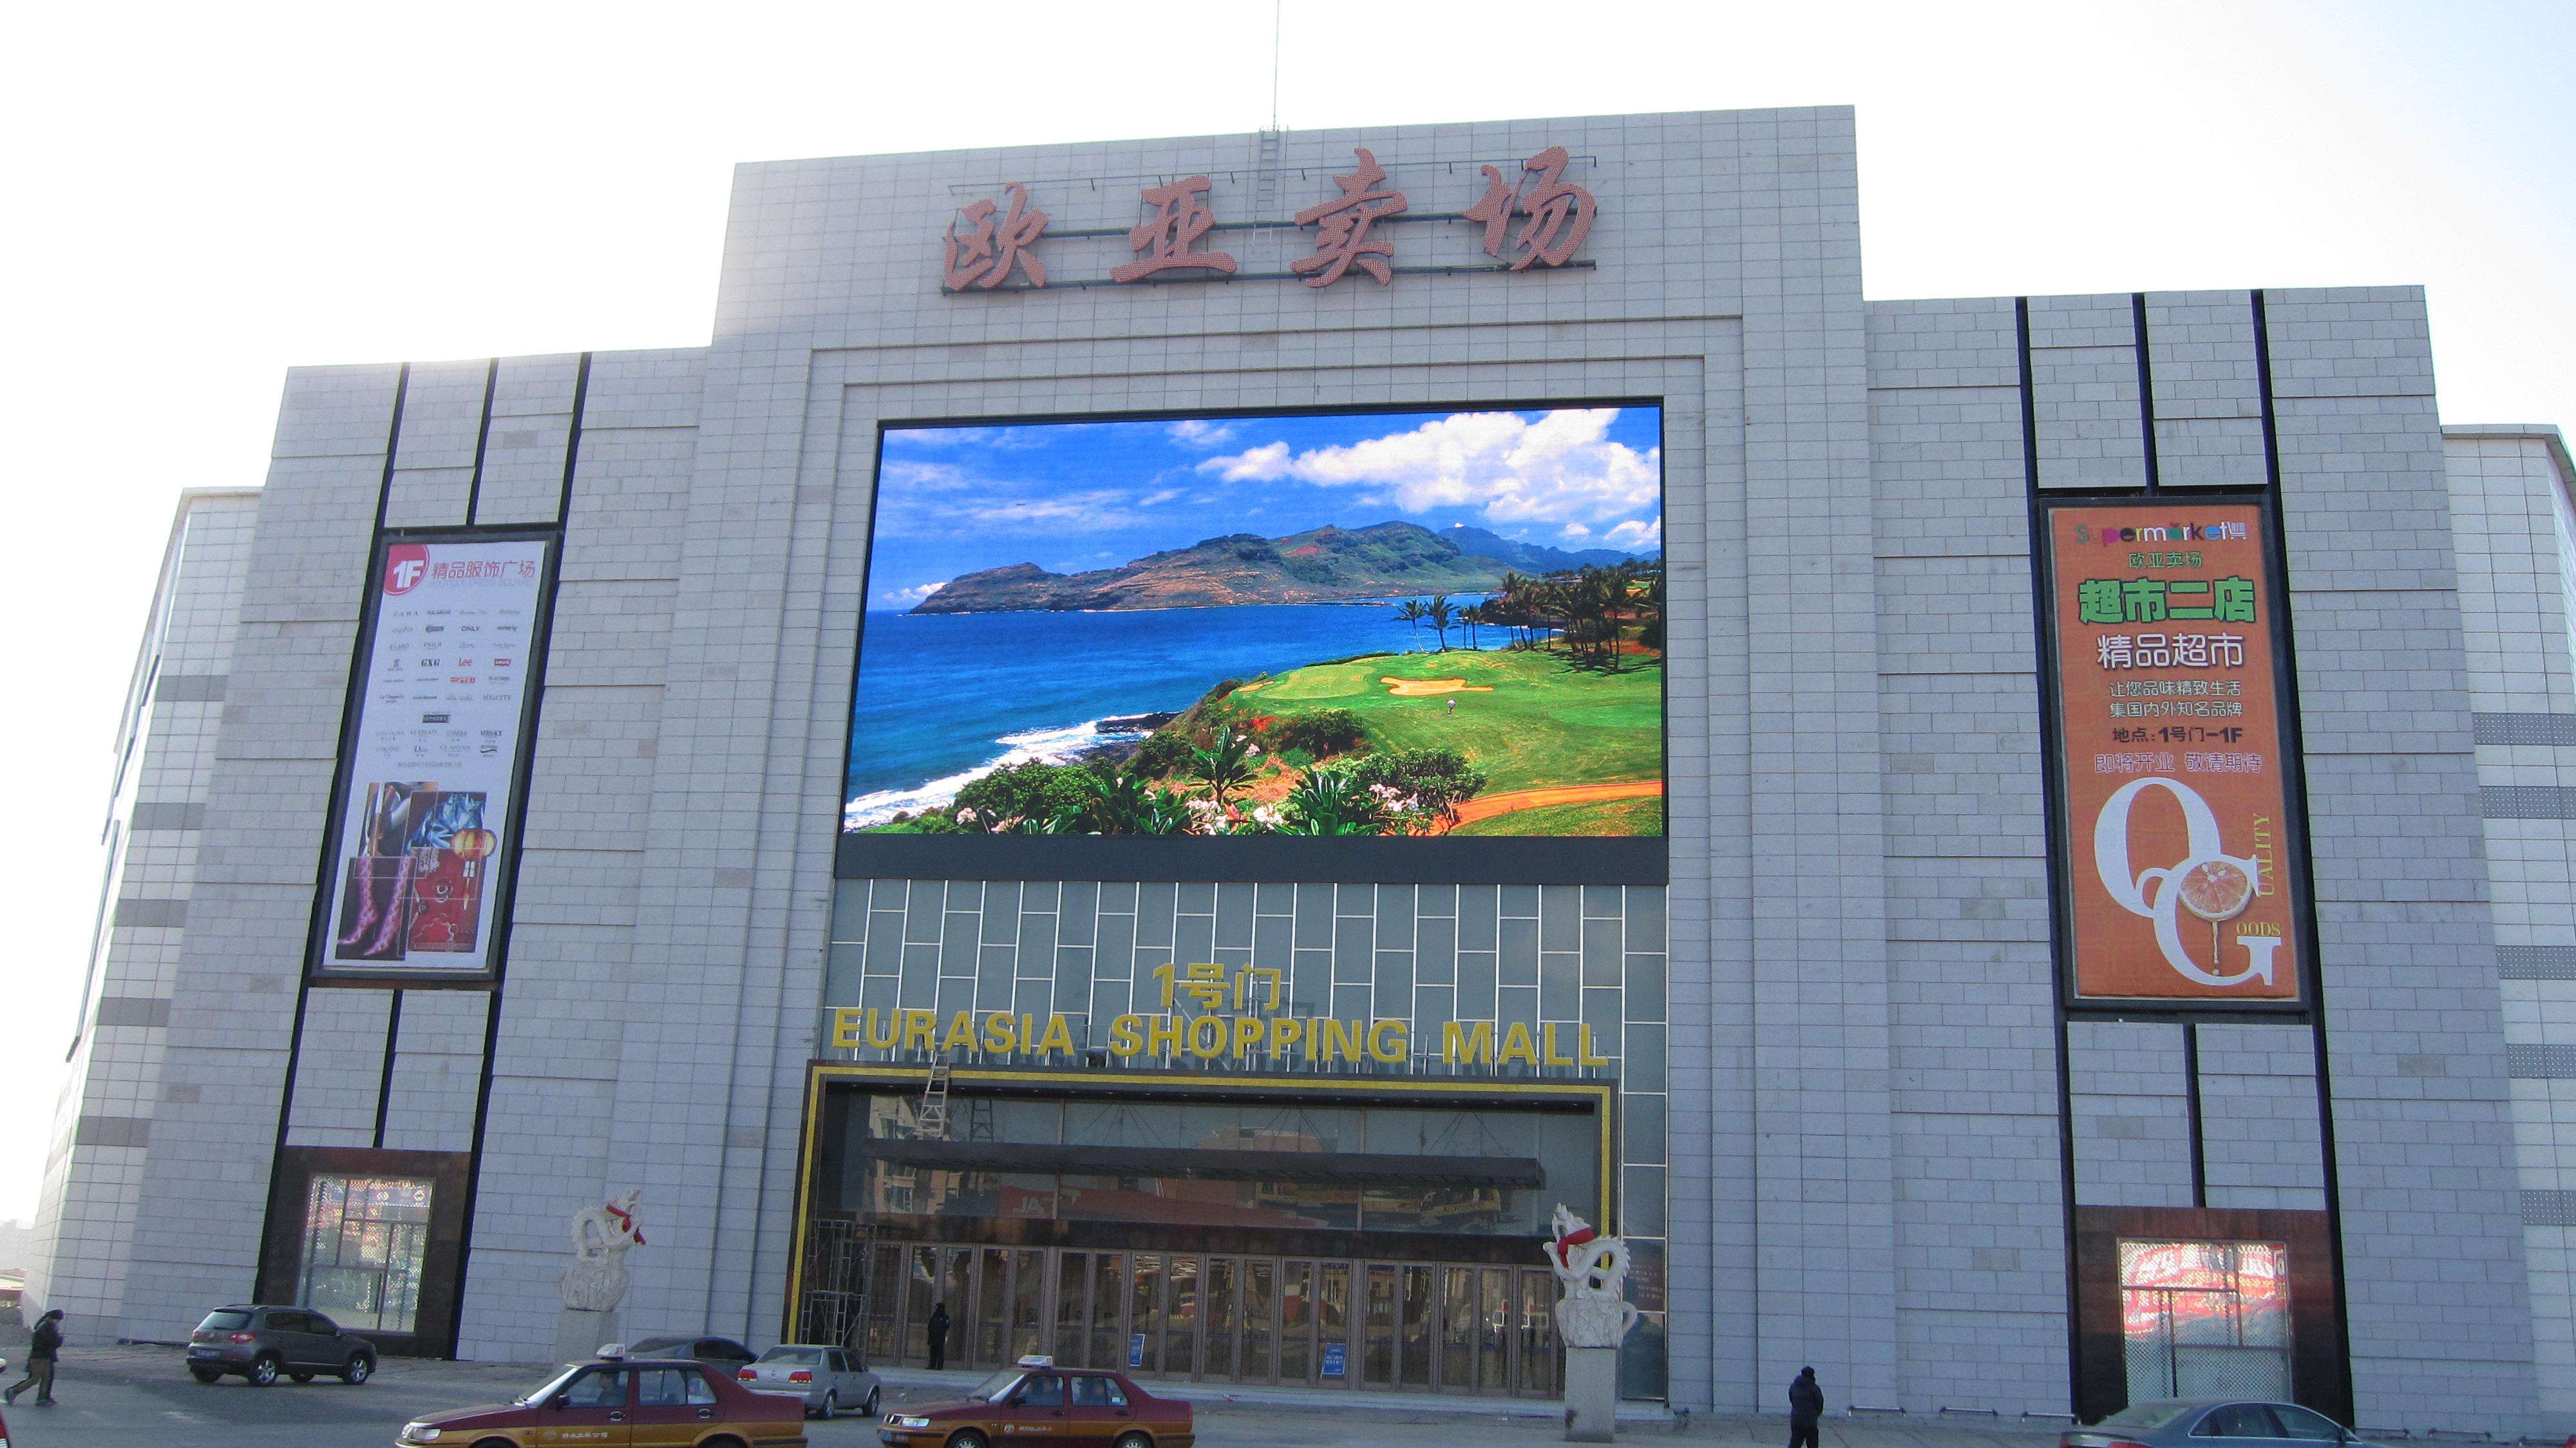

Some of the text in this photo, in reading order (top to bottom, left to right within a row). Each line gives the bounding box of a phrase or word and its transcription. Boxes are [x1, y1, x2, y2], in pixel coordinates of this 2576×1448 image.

[943, 146, 1596, 290] 欧亚卖场
[432, 560, 536, 580] 精品服饰广场
[2128, 551, 2203, 568] 欧亚卖场
[392, 560, 425, 588] 1F
[2078, 576, 2256, 625] 超市二店
[2096, 632, 2245, 669] 精品超市
[421, 658, 440, 667] GXG
[458, 658, 472, 667] Lee
[2109, 681, 2242, 698] 让您品味精致生活
[2110, 701, 2243, 718] 集国内外知名品牌
[2094, 752, 2262, 773] 即将开业 敬请期待
[1153, 963, 1282, 1011] 1号门
[831, 1007, 1609, 1067] EURASIA SHOPPING MALL
